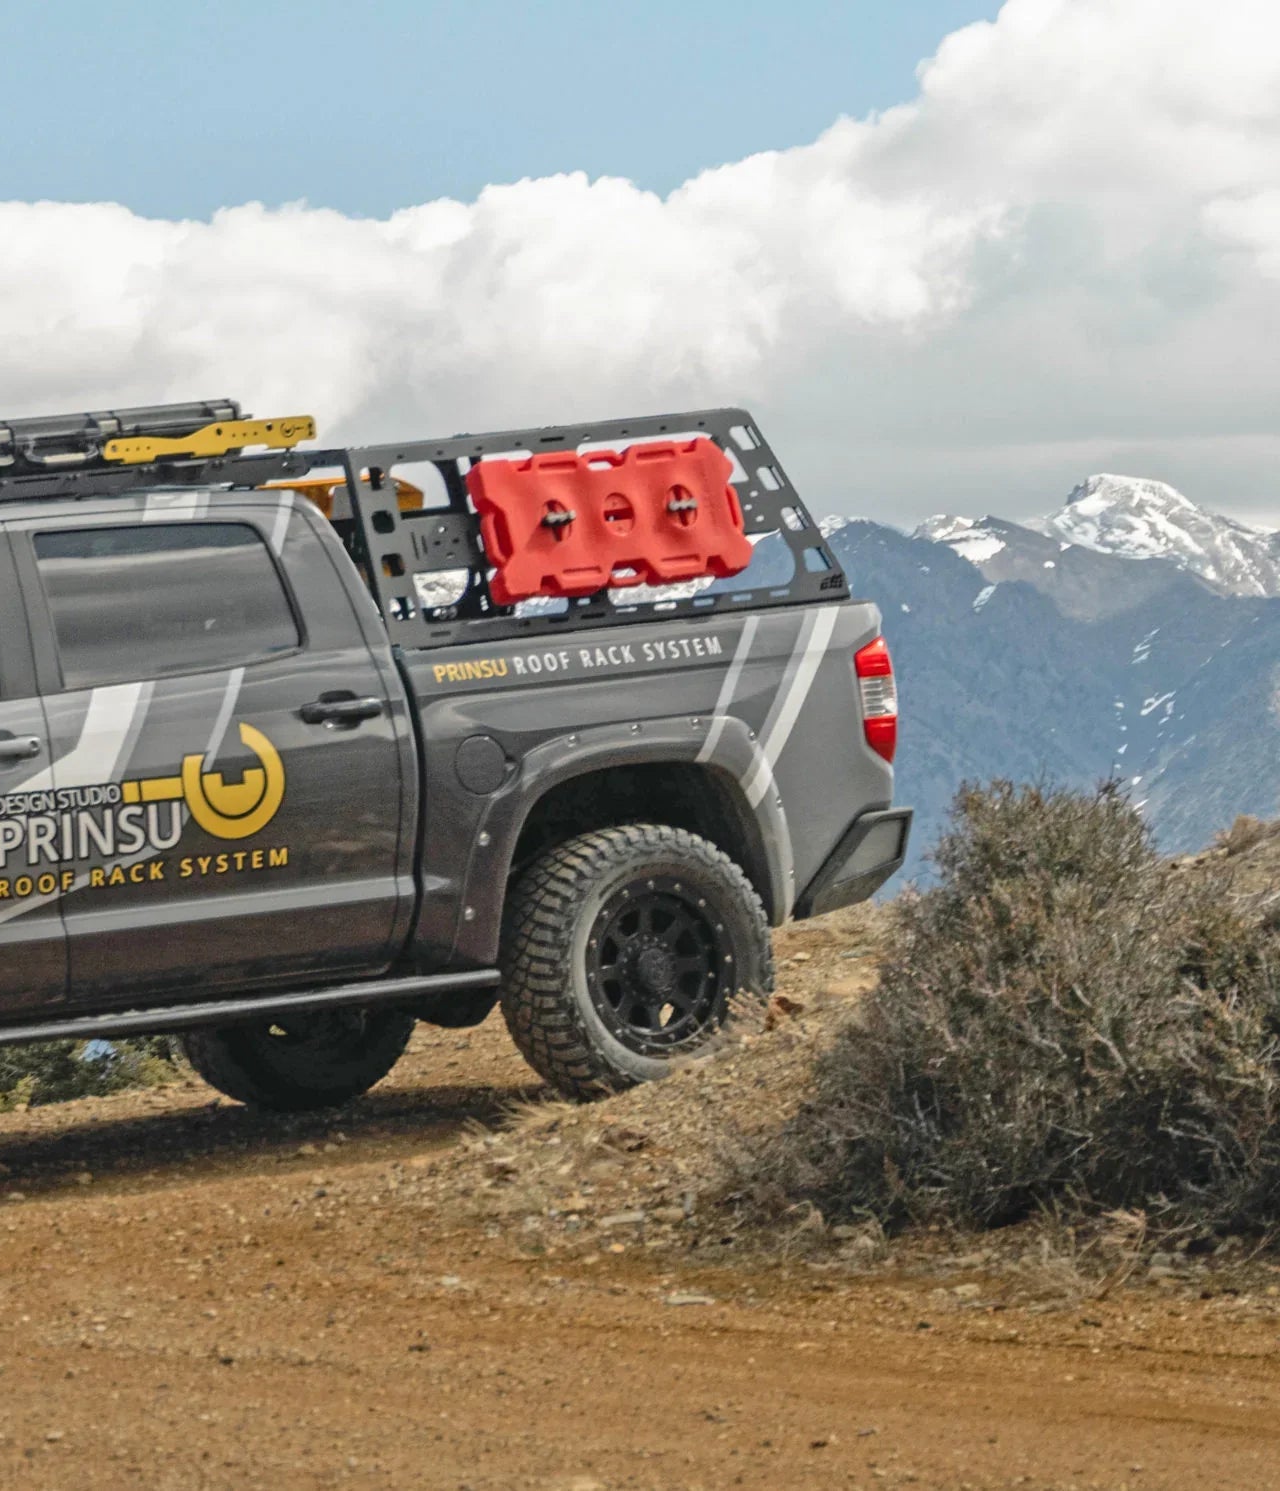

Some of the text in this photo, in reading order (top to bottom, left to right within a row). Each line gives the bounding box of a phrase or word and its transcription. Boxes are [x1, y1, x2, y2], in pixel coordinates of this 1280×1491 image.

[432, 636, 722, 683] PRINSU ROOF RACK SYSTEM
[57, 784, 120, 809] STUDIO
[91, 861, 164, 887] RACK
[180, 847, 288, 877] SYSTEM
